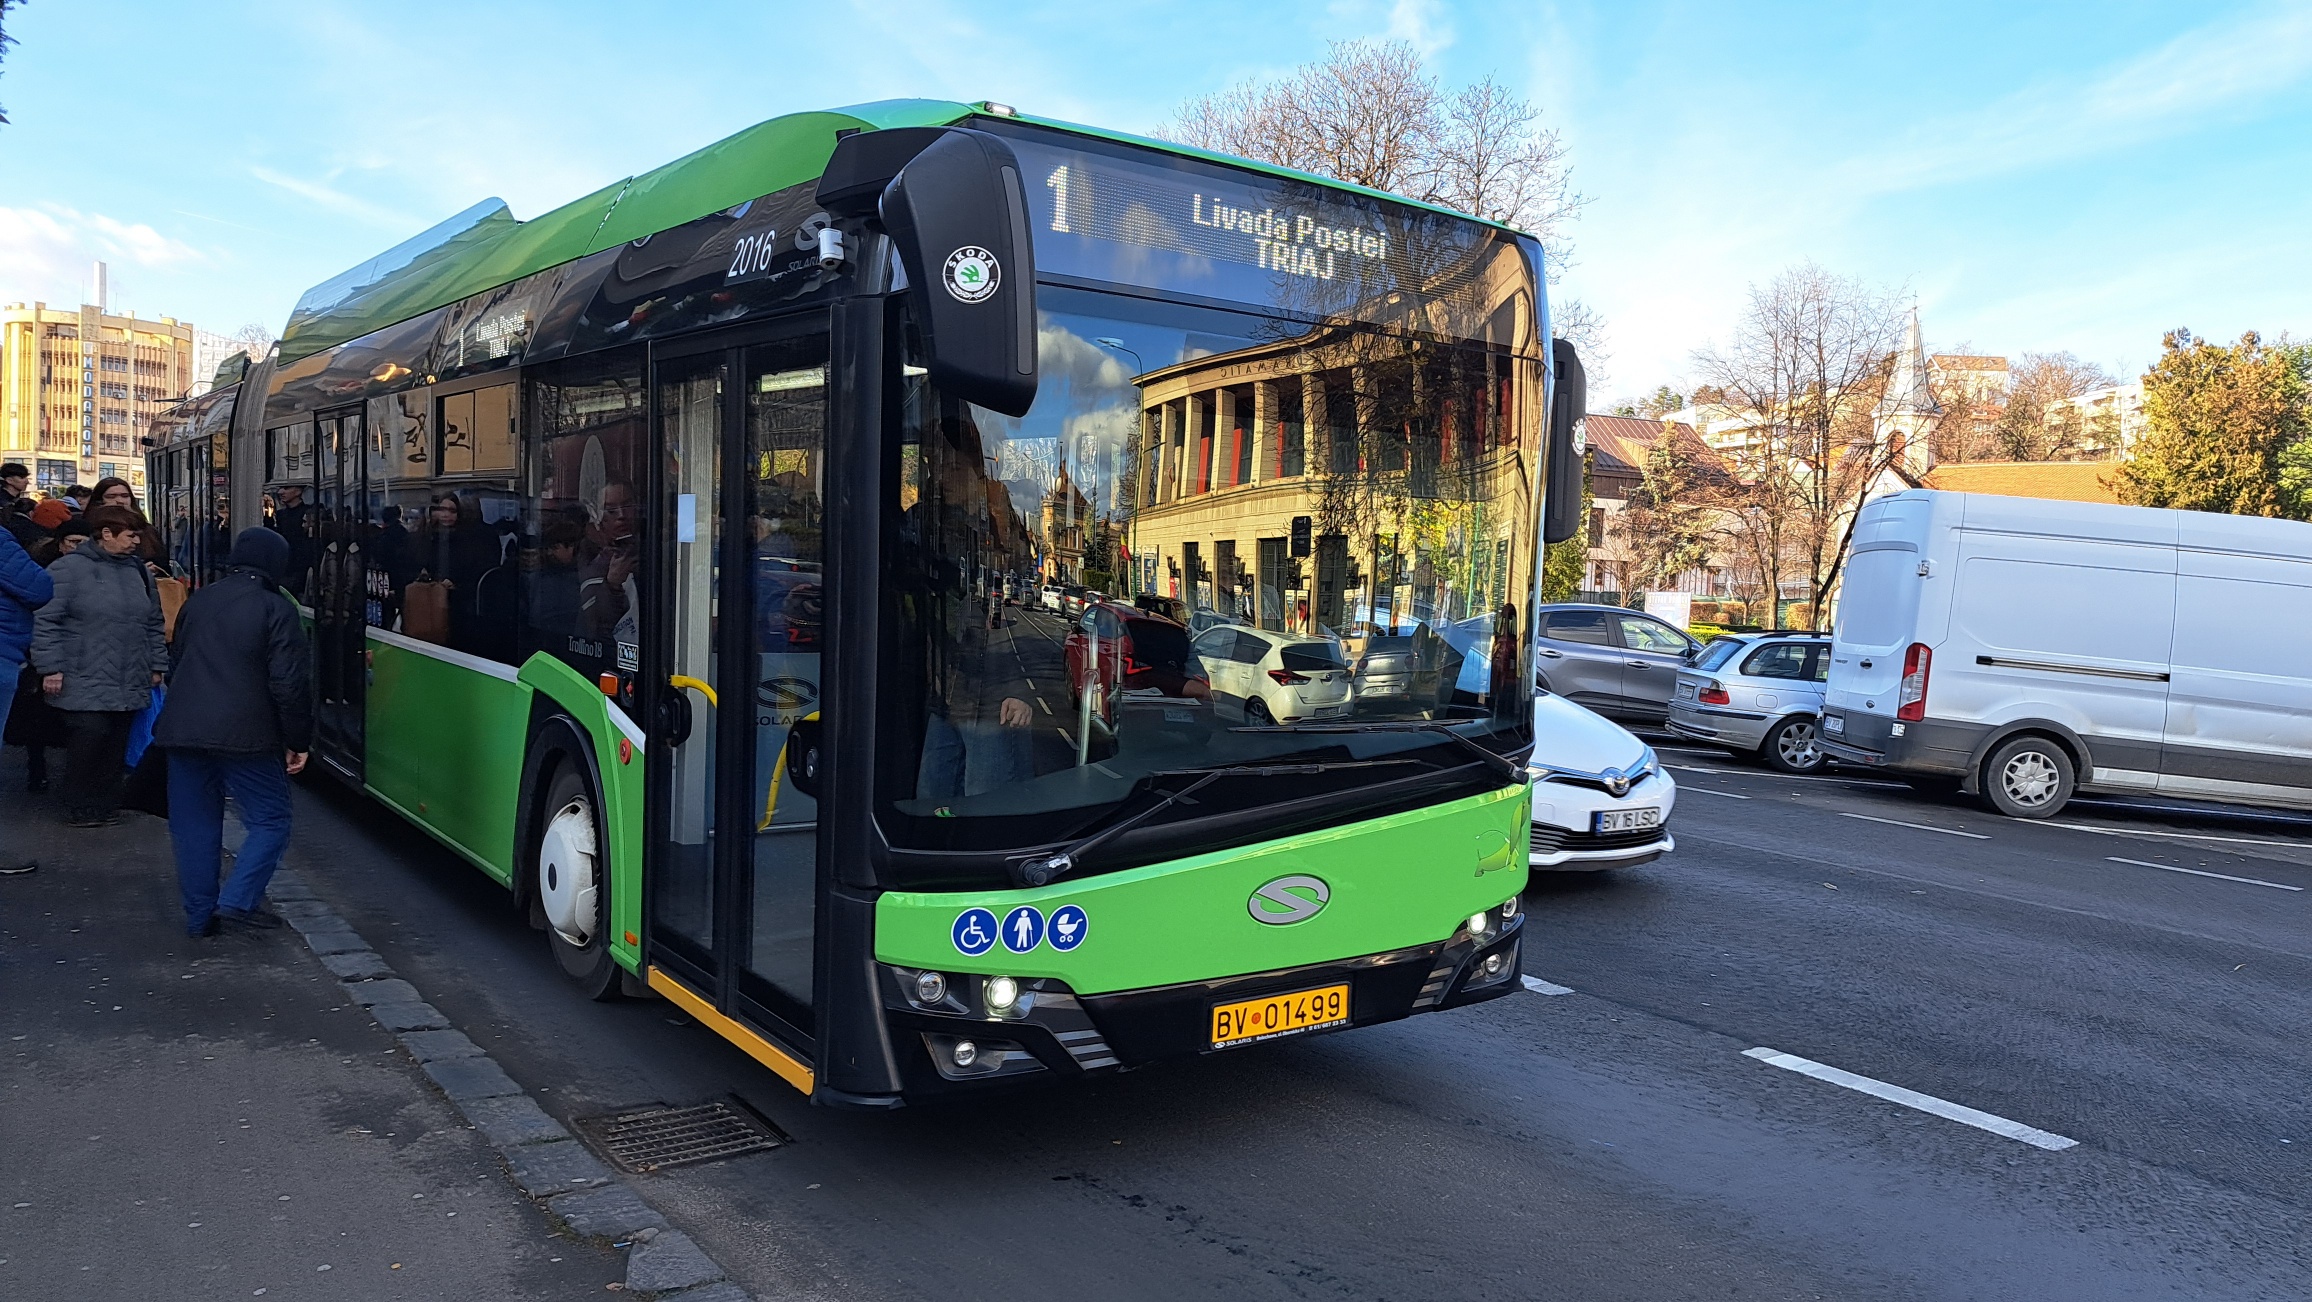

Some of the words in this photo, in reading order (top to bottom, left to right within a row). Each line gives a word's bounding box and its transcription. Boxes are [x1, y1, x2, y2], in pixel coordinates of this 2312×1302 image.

[1046, 165, 1069, 233] 1
[1194, 194, 1288, 241] Livada
[1297, 215, 1387, 260] Postei
[727, 229, 775, 278] 2016
[948, 248, 995, 269] SKODA
[1255, 238, 1333, 280] TRIAJ
[83, 356, 93, 456] MODAROM
[568, 635, 594, 657] Trollino
[594, 641, 603, 658] 18
[1603, 813, 1620, 830] BV
[1634, 810, 1659, 827] LSC
[1217, 1007, 1247, 1039] BV
[1264, 992, 1340, 1030] 01499
